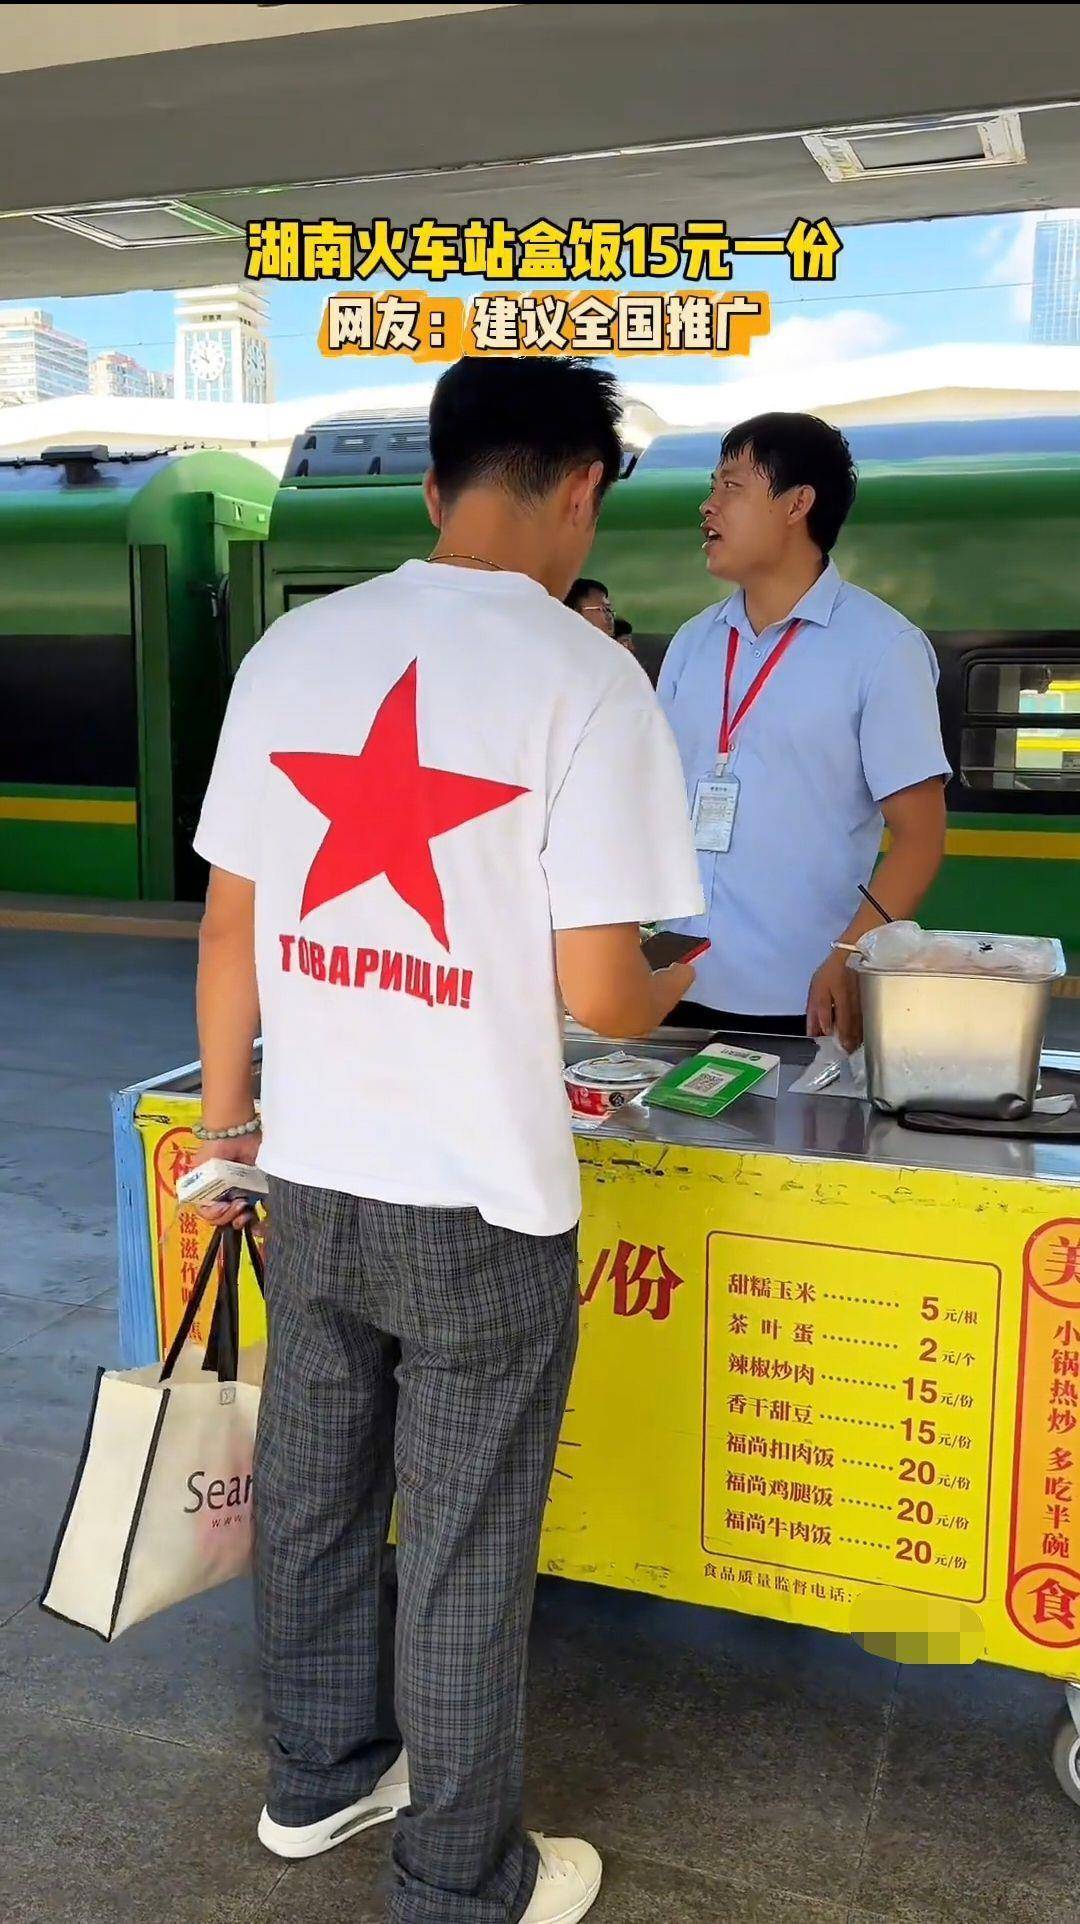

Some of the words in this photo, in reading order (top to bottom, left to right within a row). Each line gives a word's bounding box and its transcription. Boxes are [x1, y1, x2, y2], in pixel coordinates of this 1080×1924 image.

[279, 933, 473, 1009] ТОВАРИЩИ!
[728, 1273, 816, 1303] 甜糯玉米
[728, 1353, 814, 1386] 辣椒炒肉
[1047, 1320, 1080, 1434] 小锅热炒
[726, 1394, 813, 1425] 香干甜豆
[726, 1431, 835, 1469] 福尚扣肉饭
[725, 1470, 834, 1508] 福尚鸡腿饭
[1042, 1447, 1074, 1559] 多吃半碗
[724, 1508, 832, 1546] 福尚牛肉饭
[1026, 1577, 1080, 1630] 食
